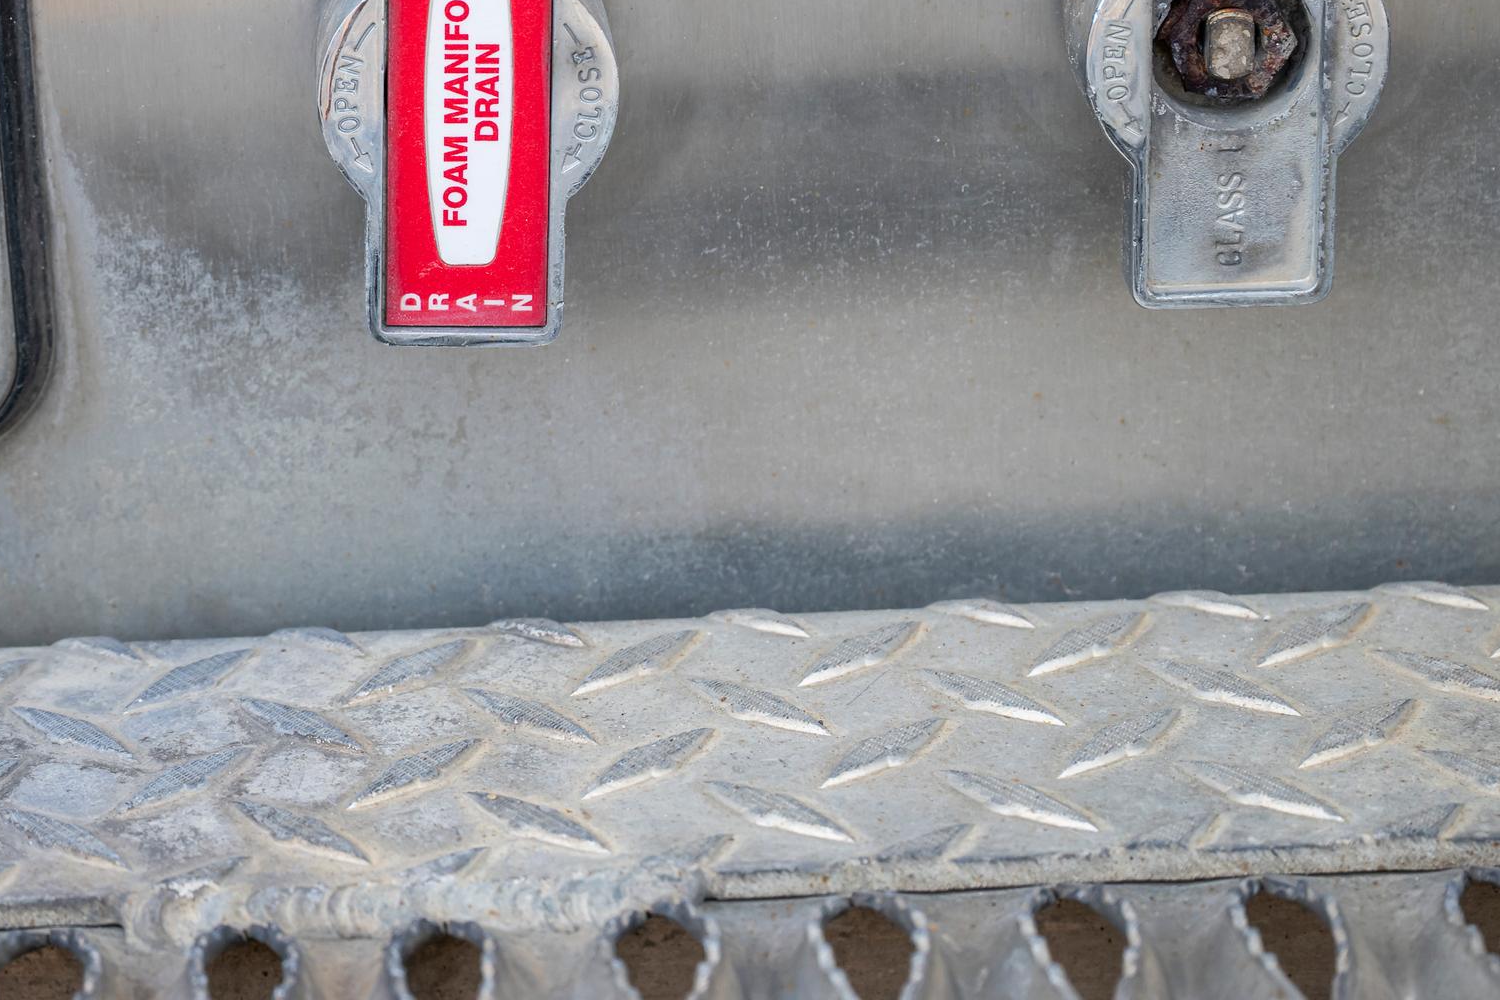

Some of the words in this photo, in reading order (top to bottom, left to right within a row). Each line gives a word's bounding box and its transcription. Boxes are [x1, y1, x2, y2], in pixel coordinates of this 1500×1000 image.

[332, 53, 366, 136] OPEN
[473, 42, 501, 143] DRAIN
[571, 43, 606, 142] CLOSE
[1100, 20, 1132, 103] OPEN
[1345, 1, 1373, 96] CLOSE
[442, 136, 469, 226] FOAM
[1215, 170, 1246, 268] CLASS
